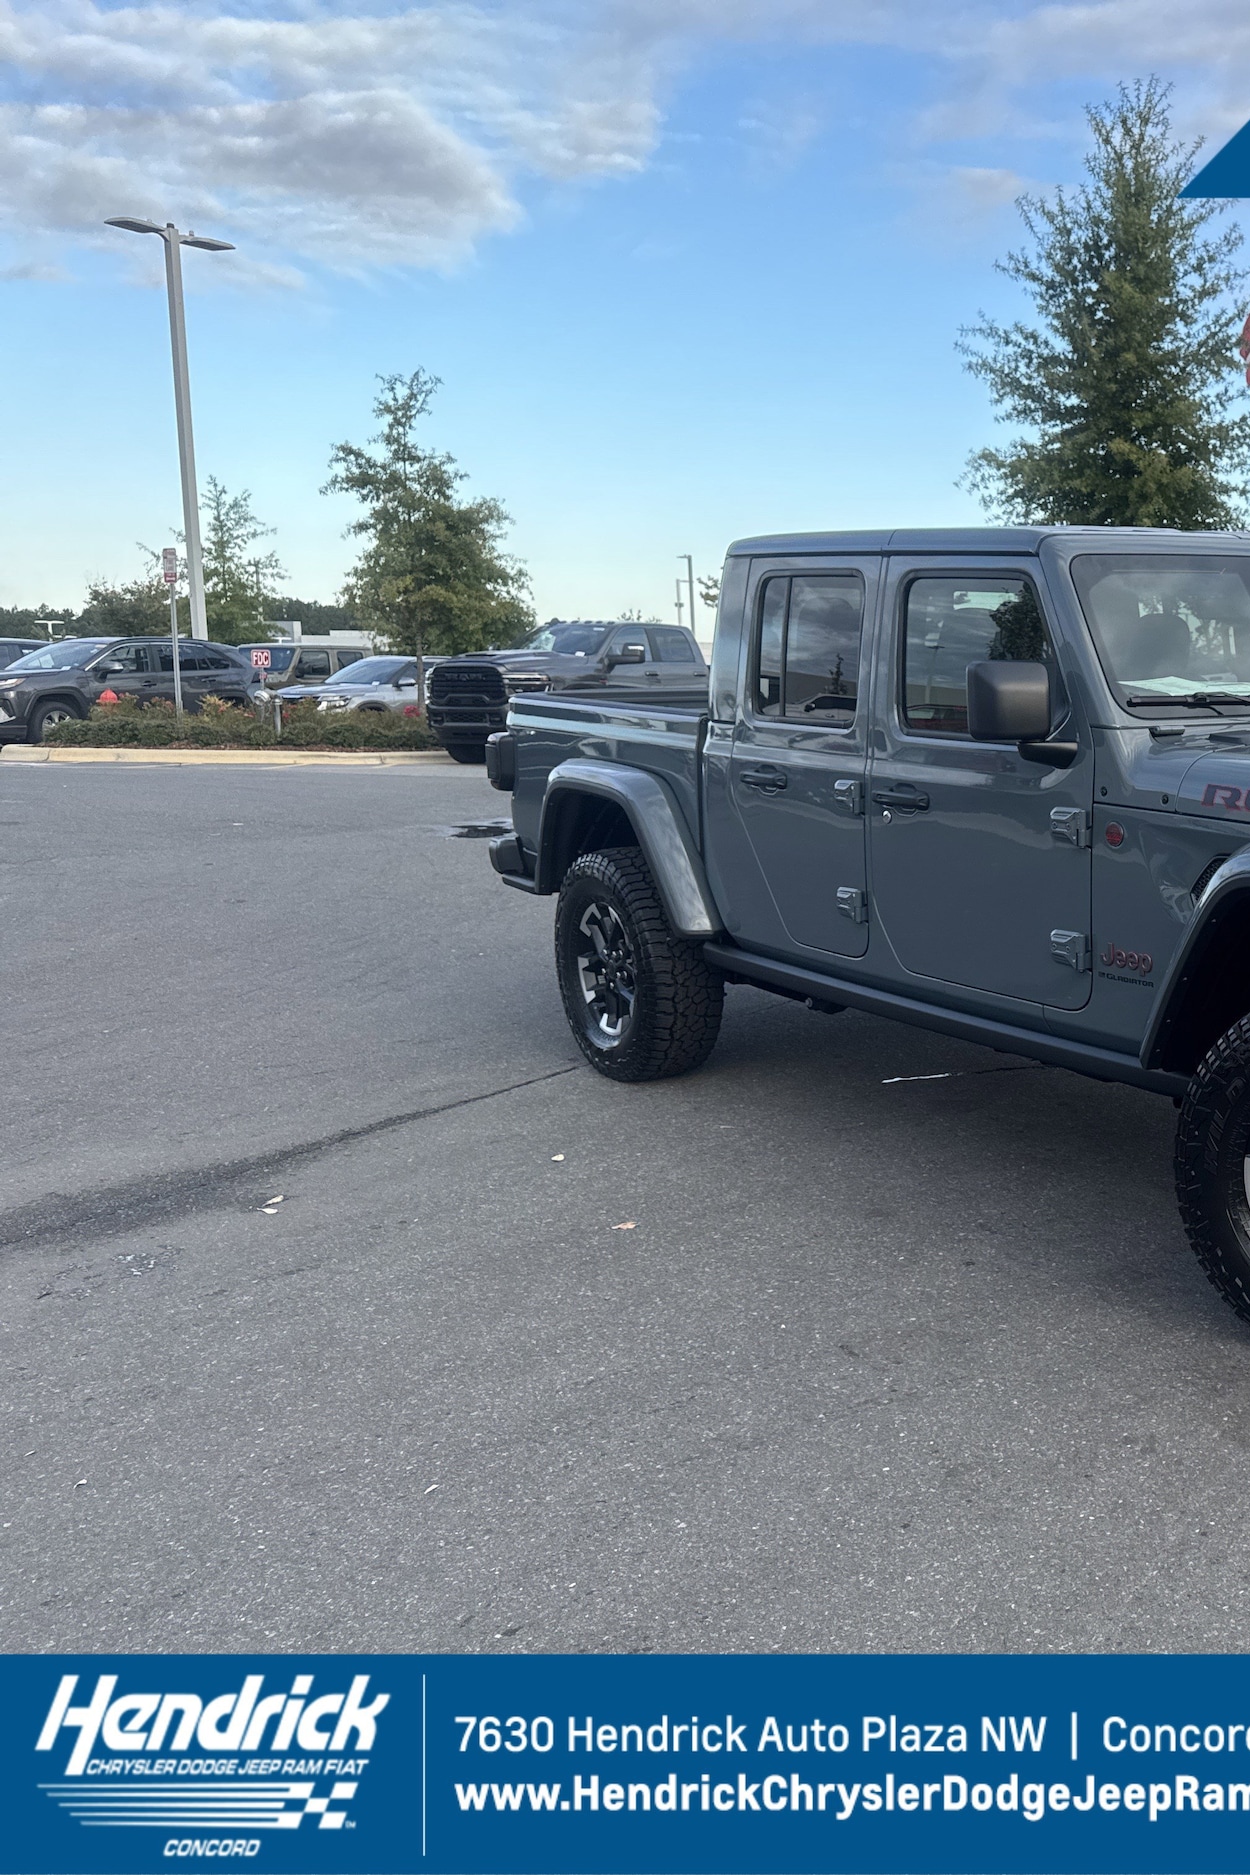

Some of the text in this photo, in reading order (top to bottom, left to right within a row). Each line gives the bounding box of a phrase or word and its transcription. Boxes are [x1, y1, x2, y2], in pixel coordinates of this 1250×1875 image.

[253, 652, 268, 665] FDC
[1100, 942, 1153, 977] Jeep
[1106, 973, 1154, 988] GLADIATOR
